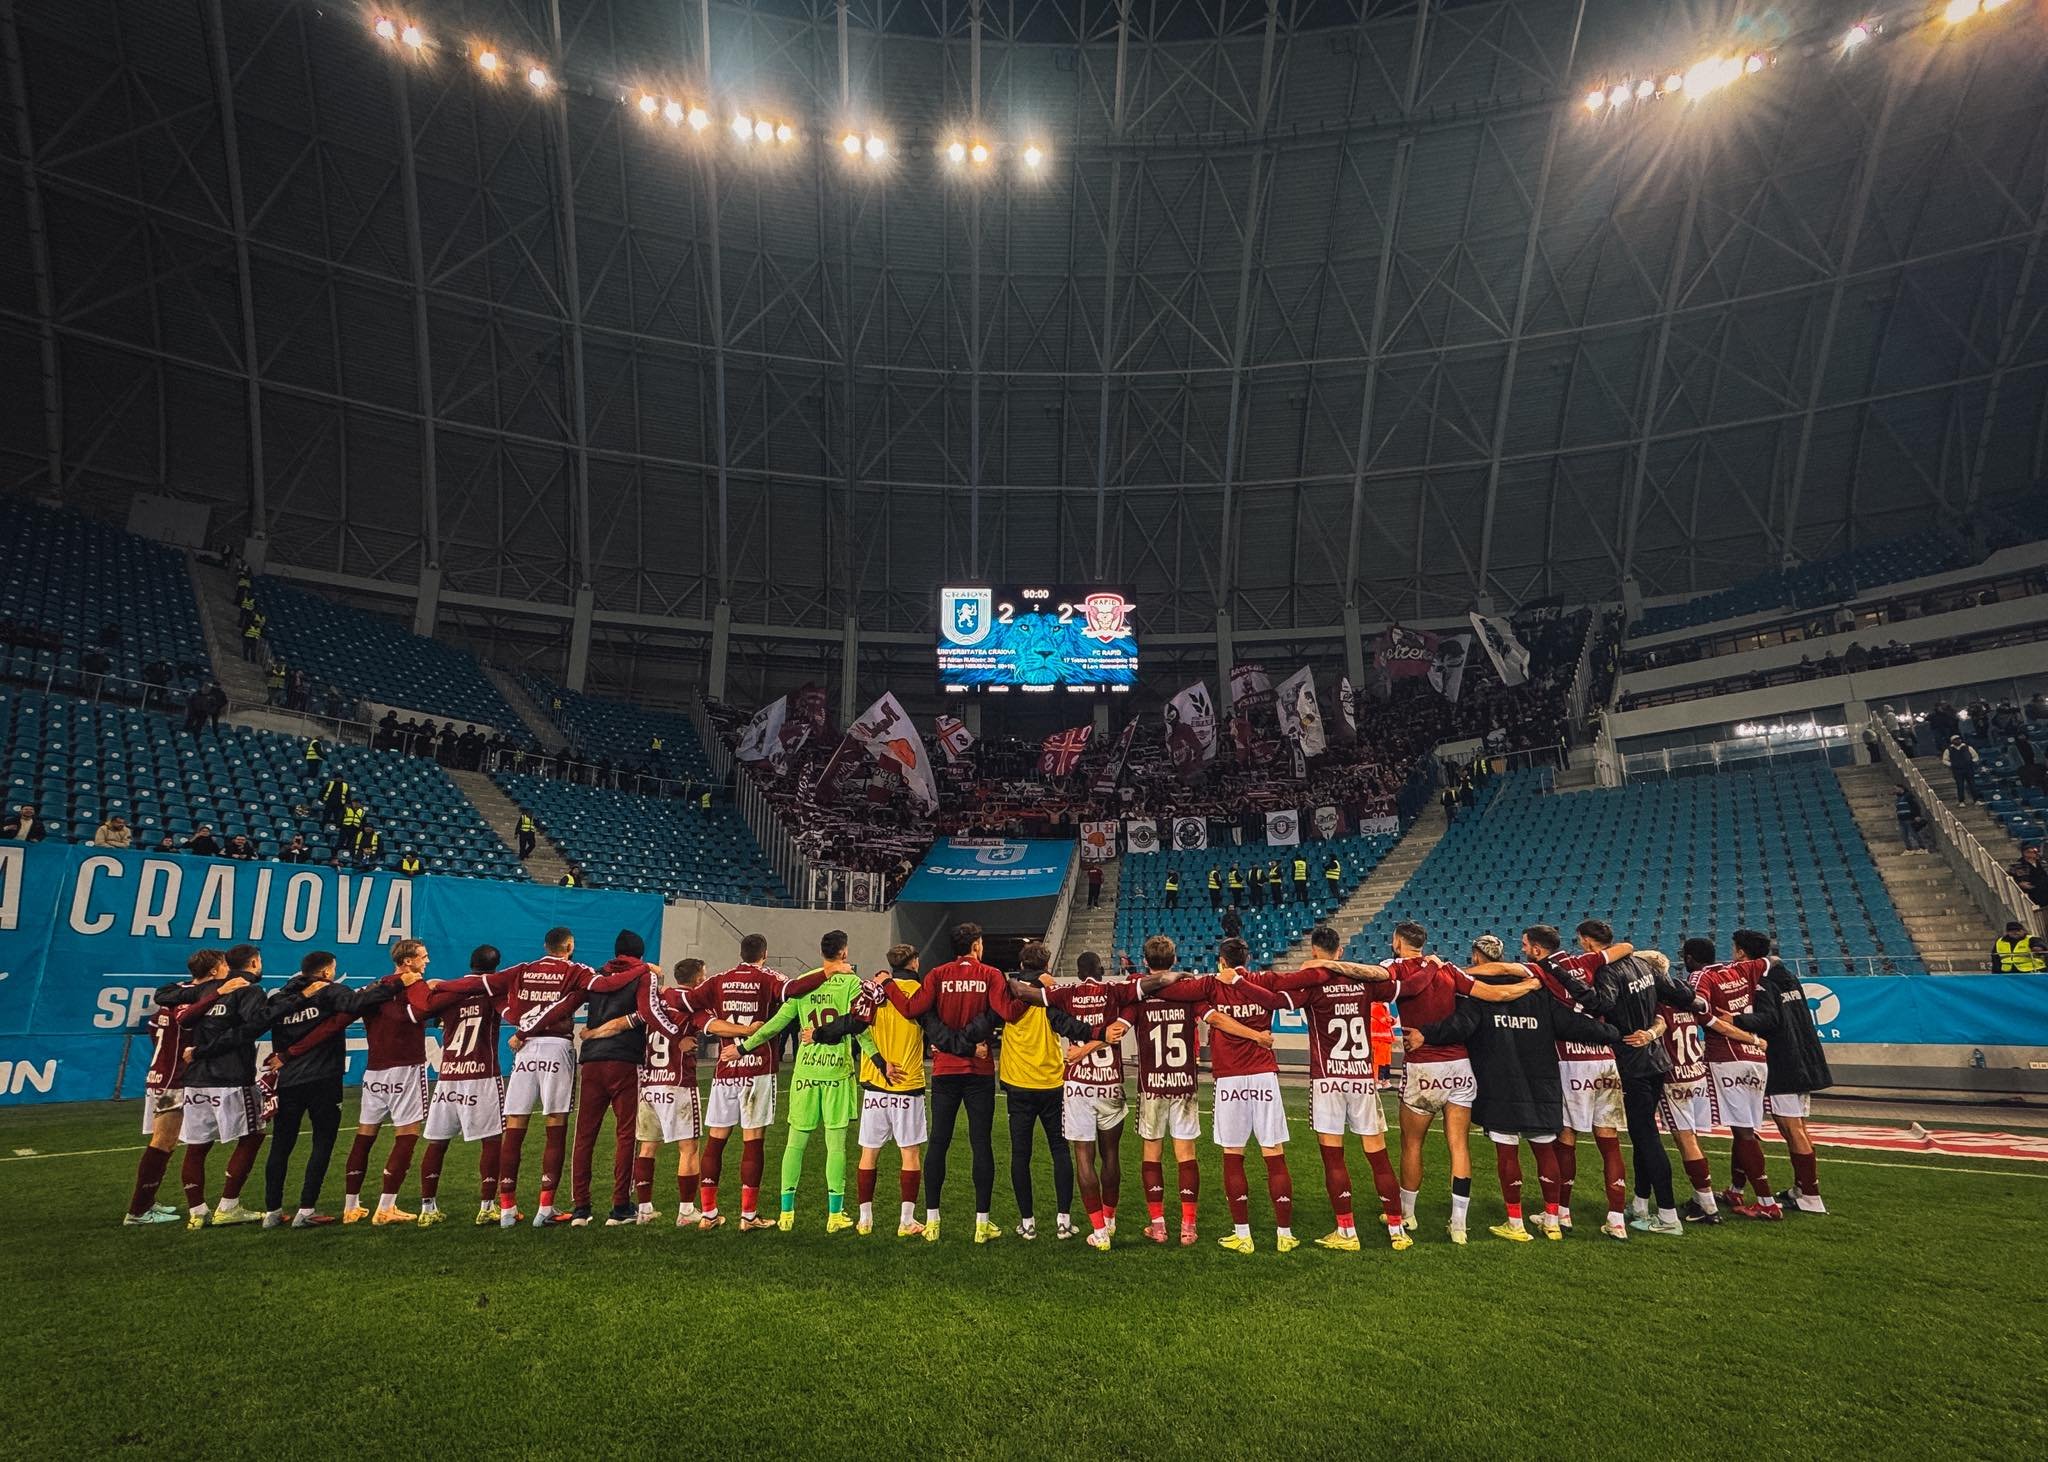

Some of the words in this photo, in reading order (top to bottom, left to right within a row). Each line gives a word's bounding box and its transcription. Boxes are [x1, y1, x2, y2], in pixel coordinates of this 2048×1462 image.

[944, 591, 989, 599] CRAIOVA
[1023, 589, 1050, 599] 90:00
[998, 603, 1014, 624] 2
[1033, 603, 1040, 611] 2
[1057, 603, 1073, 624] 2
[937, 648, 987, 656] UNIVERSITATEA
[927, 865, 1058, 878] SUPERBET
[69, 855, 413, 944] CRAIOVA
[722, 982, 760, 991] HOFFMAN
[941, 980, 954, 993] FC
[955, 980, 987, 993] RAPID
[1323, 983, 1365, 993] HOFFMAN
[723, 1001, 758, 1012] CIOBOTARIU
[1217, 1004, 1231, 1016] FC
[1335, 1003, 1359, 1015] DOBRE
[1083, 1012, 1104, 1026] KEITA
[1146, 1009, 1185, 1022] VULTURAR
[1494, 1015, 1508, 1028] FC
[446, 1016, 482, 1058] 47
[1328, 1017, 1369, 1060] 29
[1149, 1023, 1188, 1068] 15
[1672, 1025, 1703, 1065] 10
[1320, 1081, 1375, 1095] DACRIS
[1419, 1076, 1473, 1091] DACRIS
[1067, 1085, 1121, 1098] DACRIS
[1220, 1089, 1273, 1102] DACRIS
[864, 1096, 910, 1110] DACRIS
